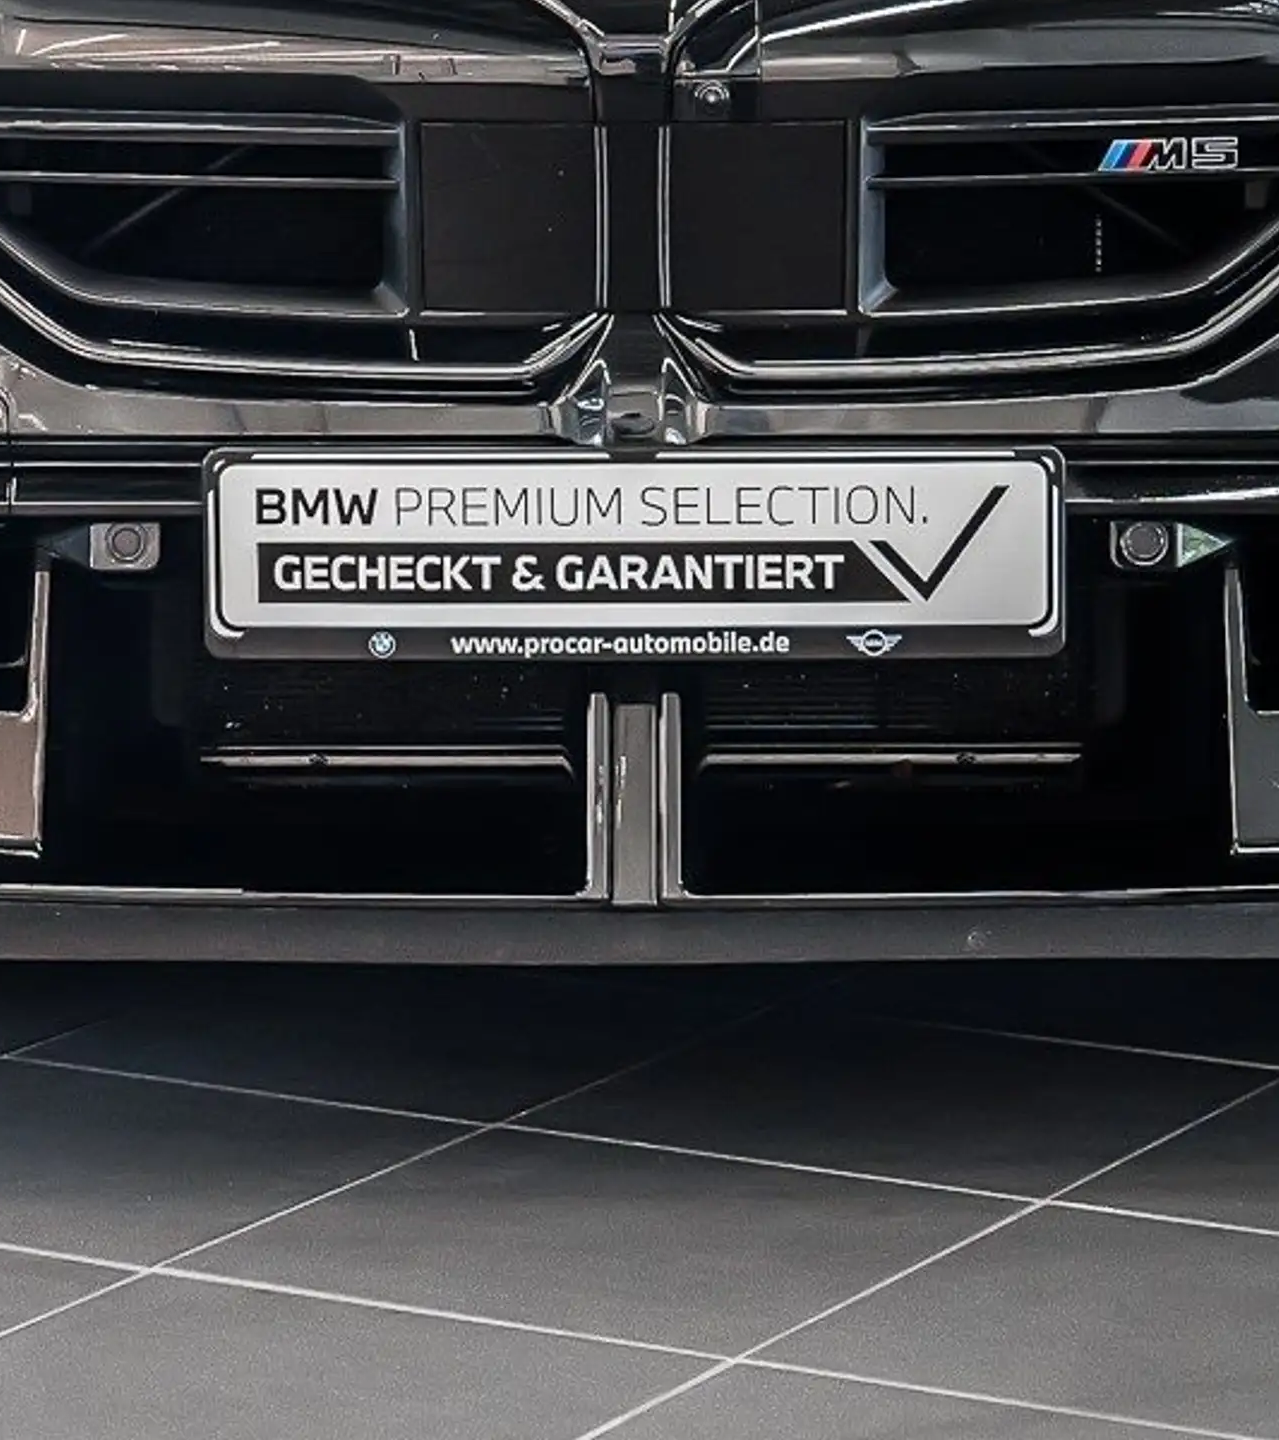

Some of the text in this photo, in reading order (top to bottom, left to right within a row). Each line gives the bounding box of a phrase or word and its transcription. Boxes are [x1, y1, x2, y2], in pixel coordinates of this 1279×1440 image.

[1144, 136, 1239, 170] M5
[255, 485, 929, 527] BMW PREMIUM SELECTION.
[273, 553, 846, 592] GECHECKT & GARANTIERT
[450, 631, 791, 658] www.procar-automobile.de
